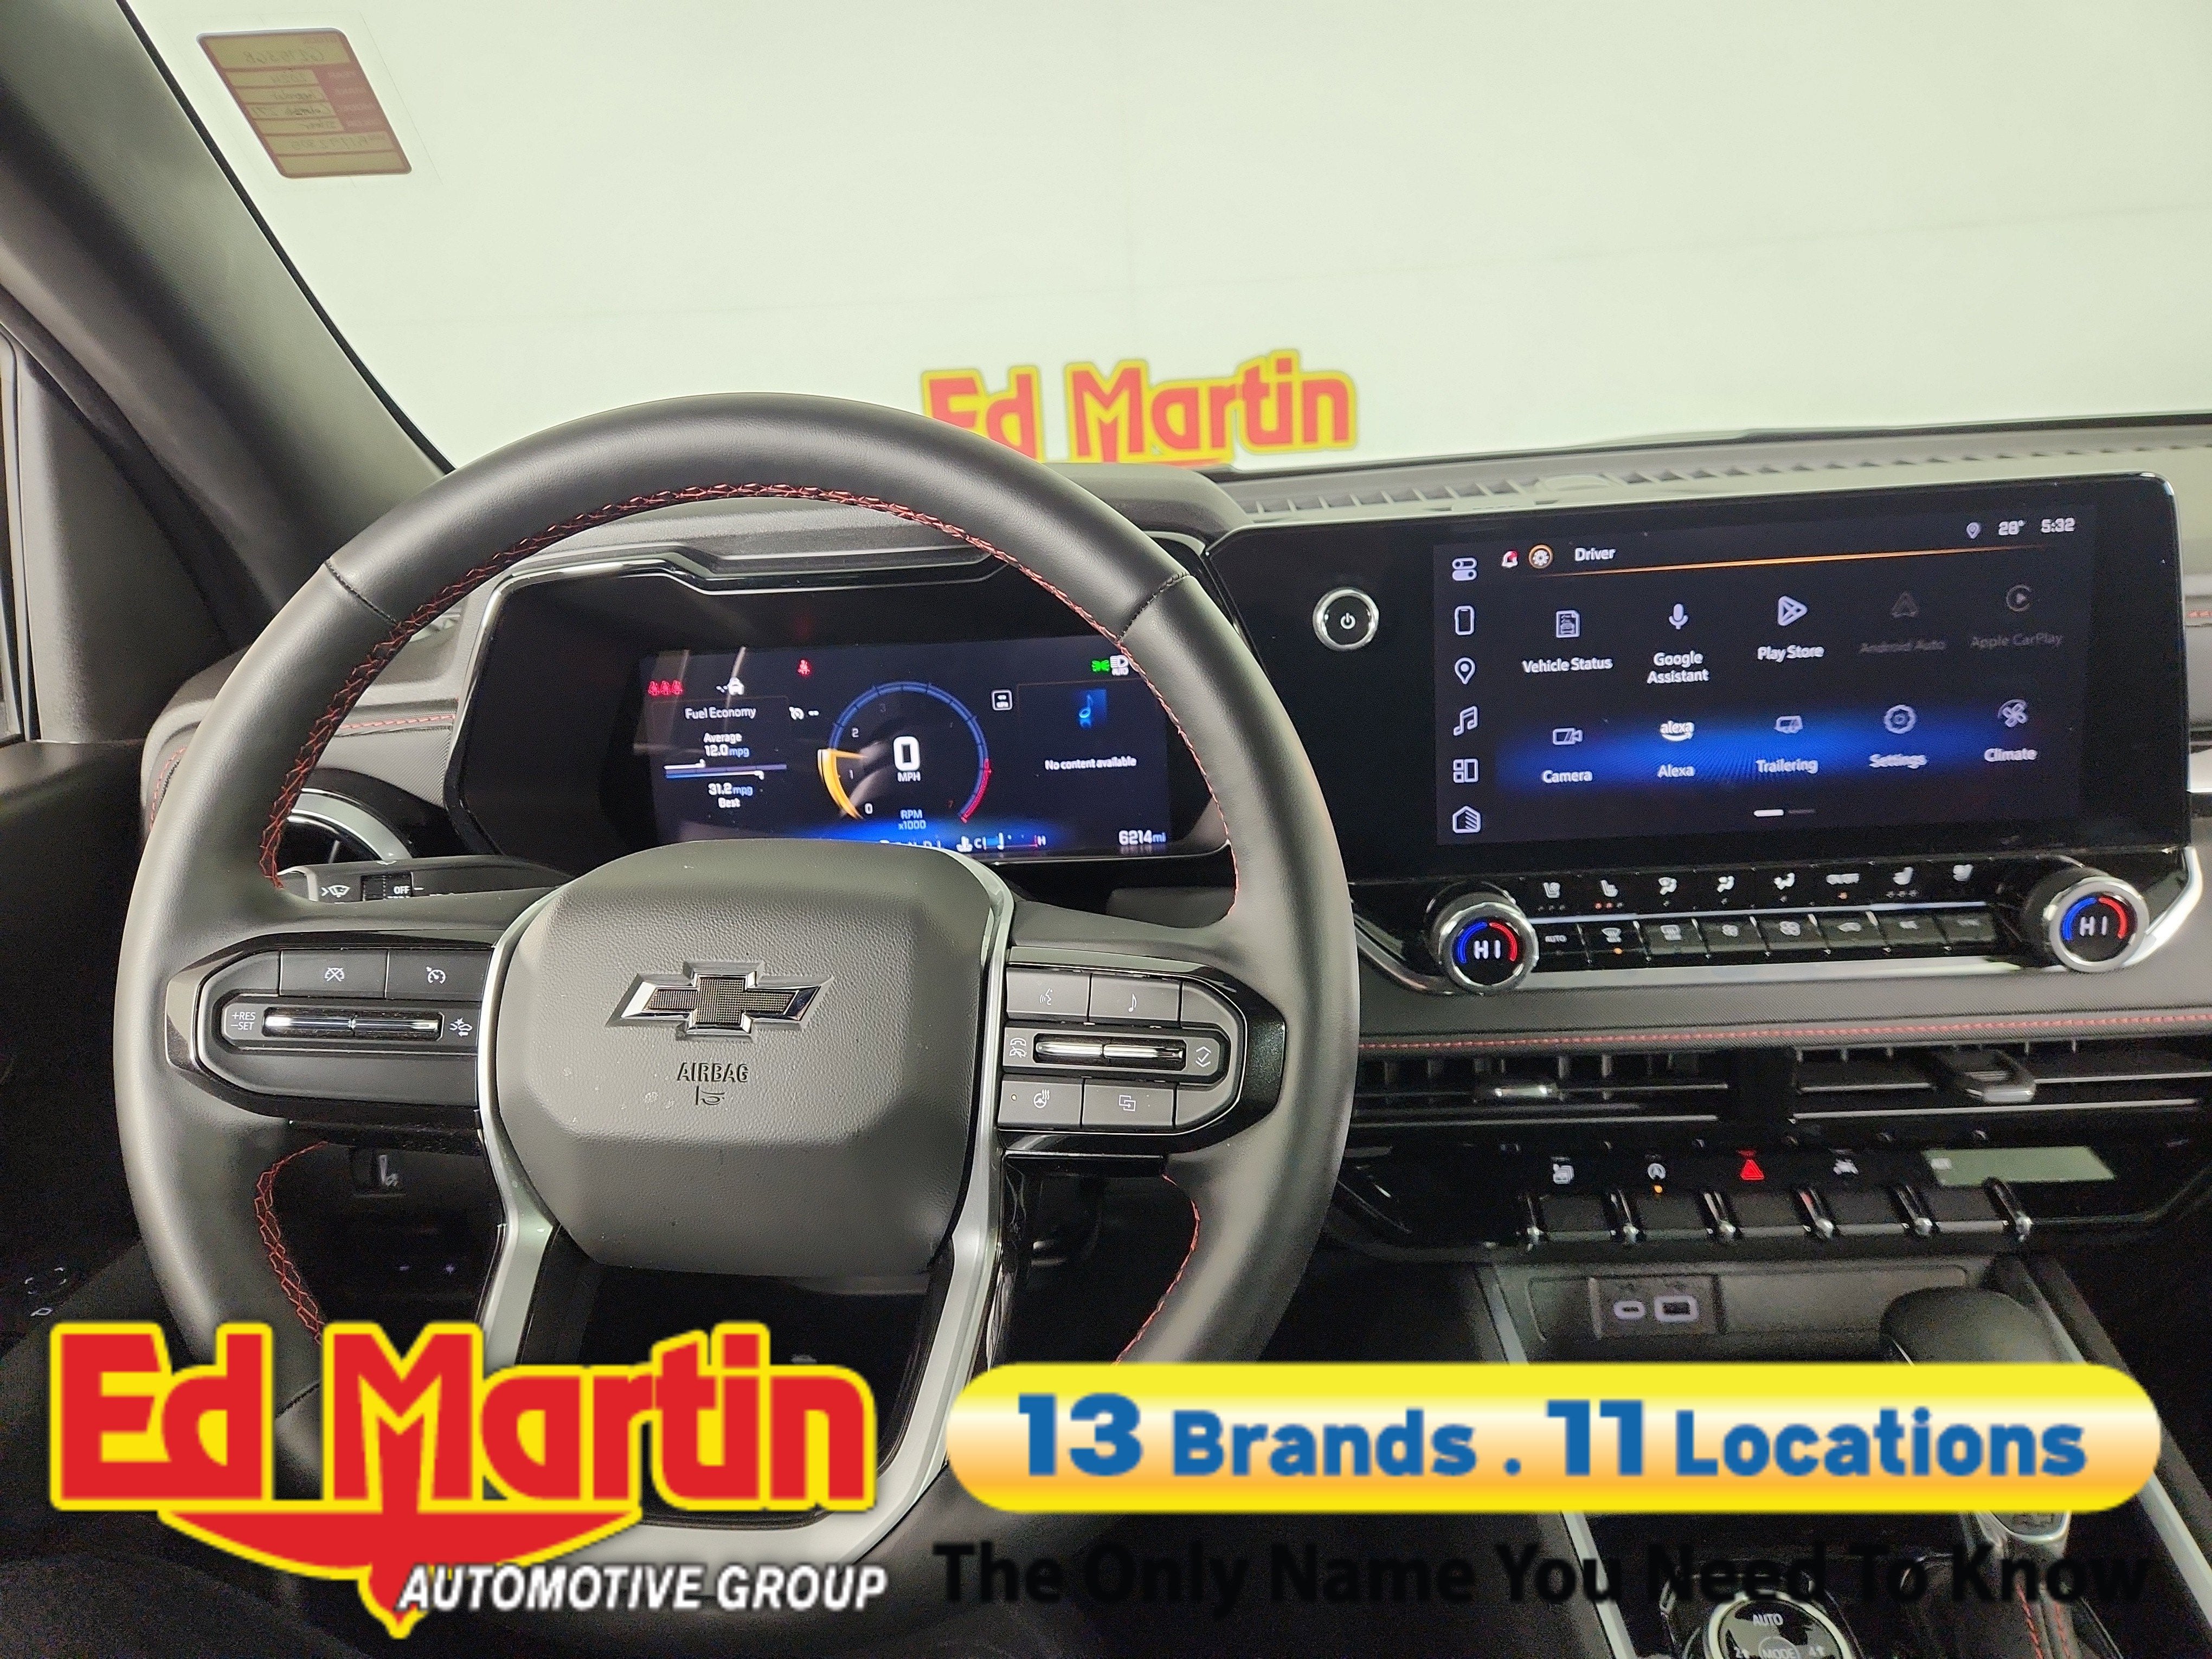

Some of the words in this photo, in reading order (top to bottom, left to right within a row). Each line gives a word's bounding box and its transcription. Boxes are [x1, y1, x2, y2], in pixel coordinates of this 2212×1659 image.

[926, 366, 1039, 461] Ed
[1068, 355, 1352, 462] Martin
[2041, 518, 2075, 533] 5:32
[1574, 548, 1616, 562] Driver
[1654, 651, 1703, 668] Google
[1757, 646, 1787, 662] Play
[1787, 644, 1824, 658] Store
[1522, 659, 1570, 673] Vehicle
[1571, 656, 1613, 670] Status
[1647, 668, 1709, 684] Assistant
[685, 708, 708, 719] Fuel
[709, 706, 756, 719] Economy
[851, 727, 859, 738] 2
[1660, 721, 1695, 734] alexa
[703, 732, 742, 744] Average
[893, 736, 921, 771] 0
[1984, 748, 2037, 762] Climate
[1045, 760, 1060, 770] No
[1060, 758, 1096, 770] content
[1096, 756, 1137, 768] available
[1756, 758, 1818, 774] Trailering
[897, 771, 921, 782] MPH
[1542, 770, 1593, 784] Camera
[1657, 764, 1695, 779] Alexa
[864, 803, 873, 814] 0
[900, 809, 923, 820] RPM
[1037, 835, 1046, 846] H
[393, 885, 411, 895] OFF
[2079, 916, 2108, 936] HI
[1473, 940, 1501, 960] HI
[677, 1061, 749, 1083] AIRBAG
[1752, 1613, 1783, 1626] AUTO
